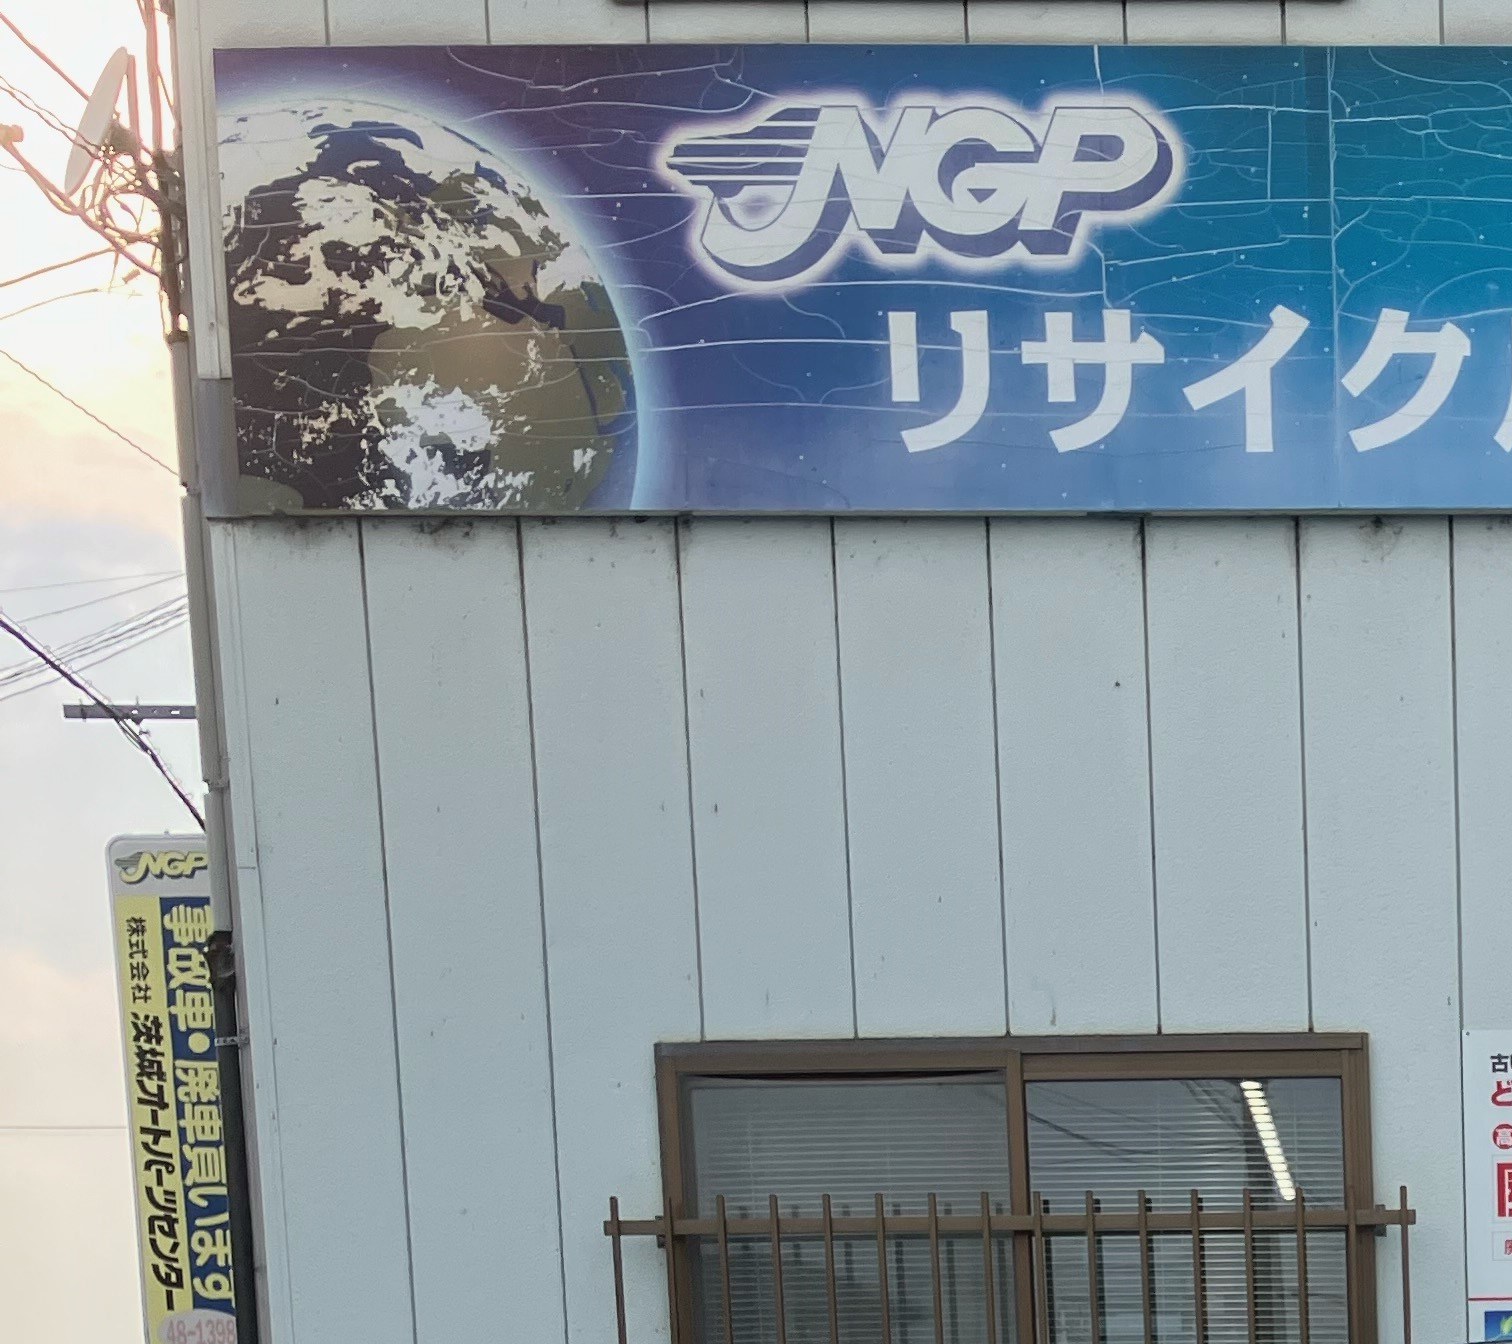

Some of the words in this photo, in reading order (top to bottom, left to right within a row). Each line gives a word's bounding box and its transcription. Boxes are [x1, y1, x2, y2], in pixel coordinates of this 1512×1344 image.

[690, 104, 1173, 280] NGP
[116, 851, 208, 884] NGP
[126, 916, 153, 1004] 株式会社
[130, 1011, 184, 1311] 茨城オートパーツセンター
